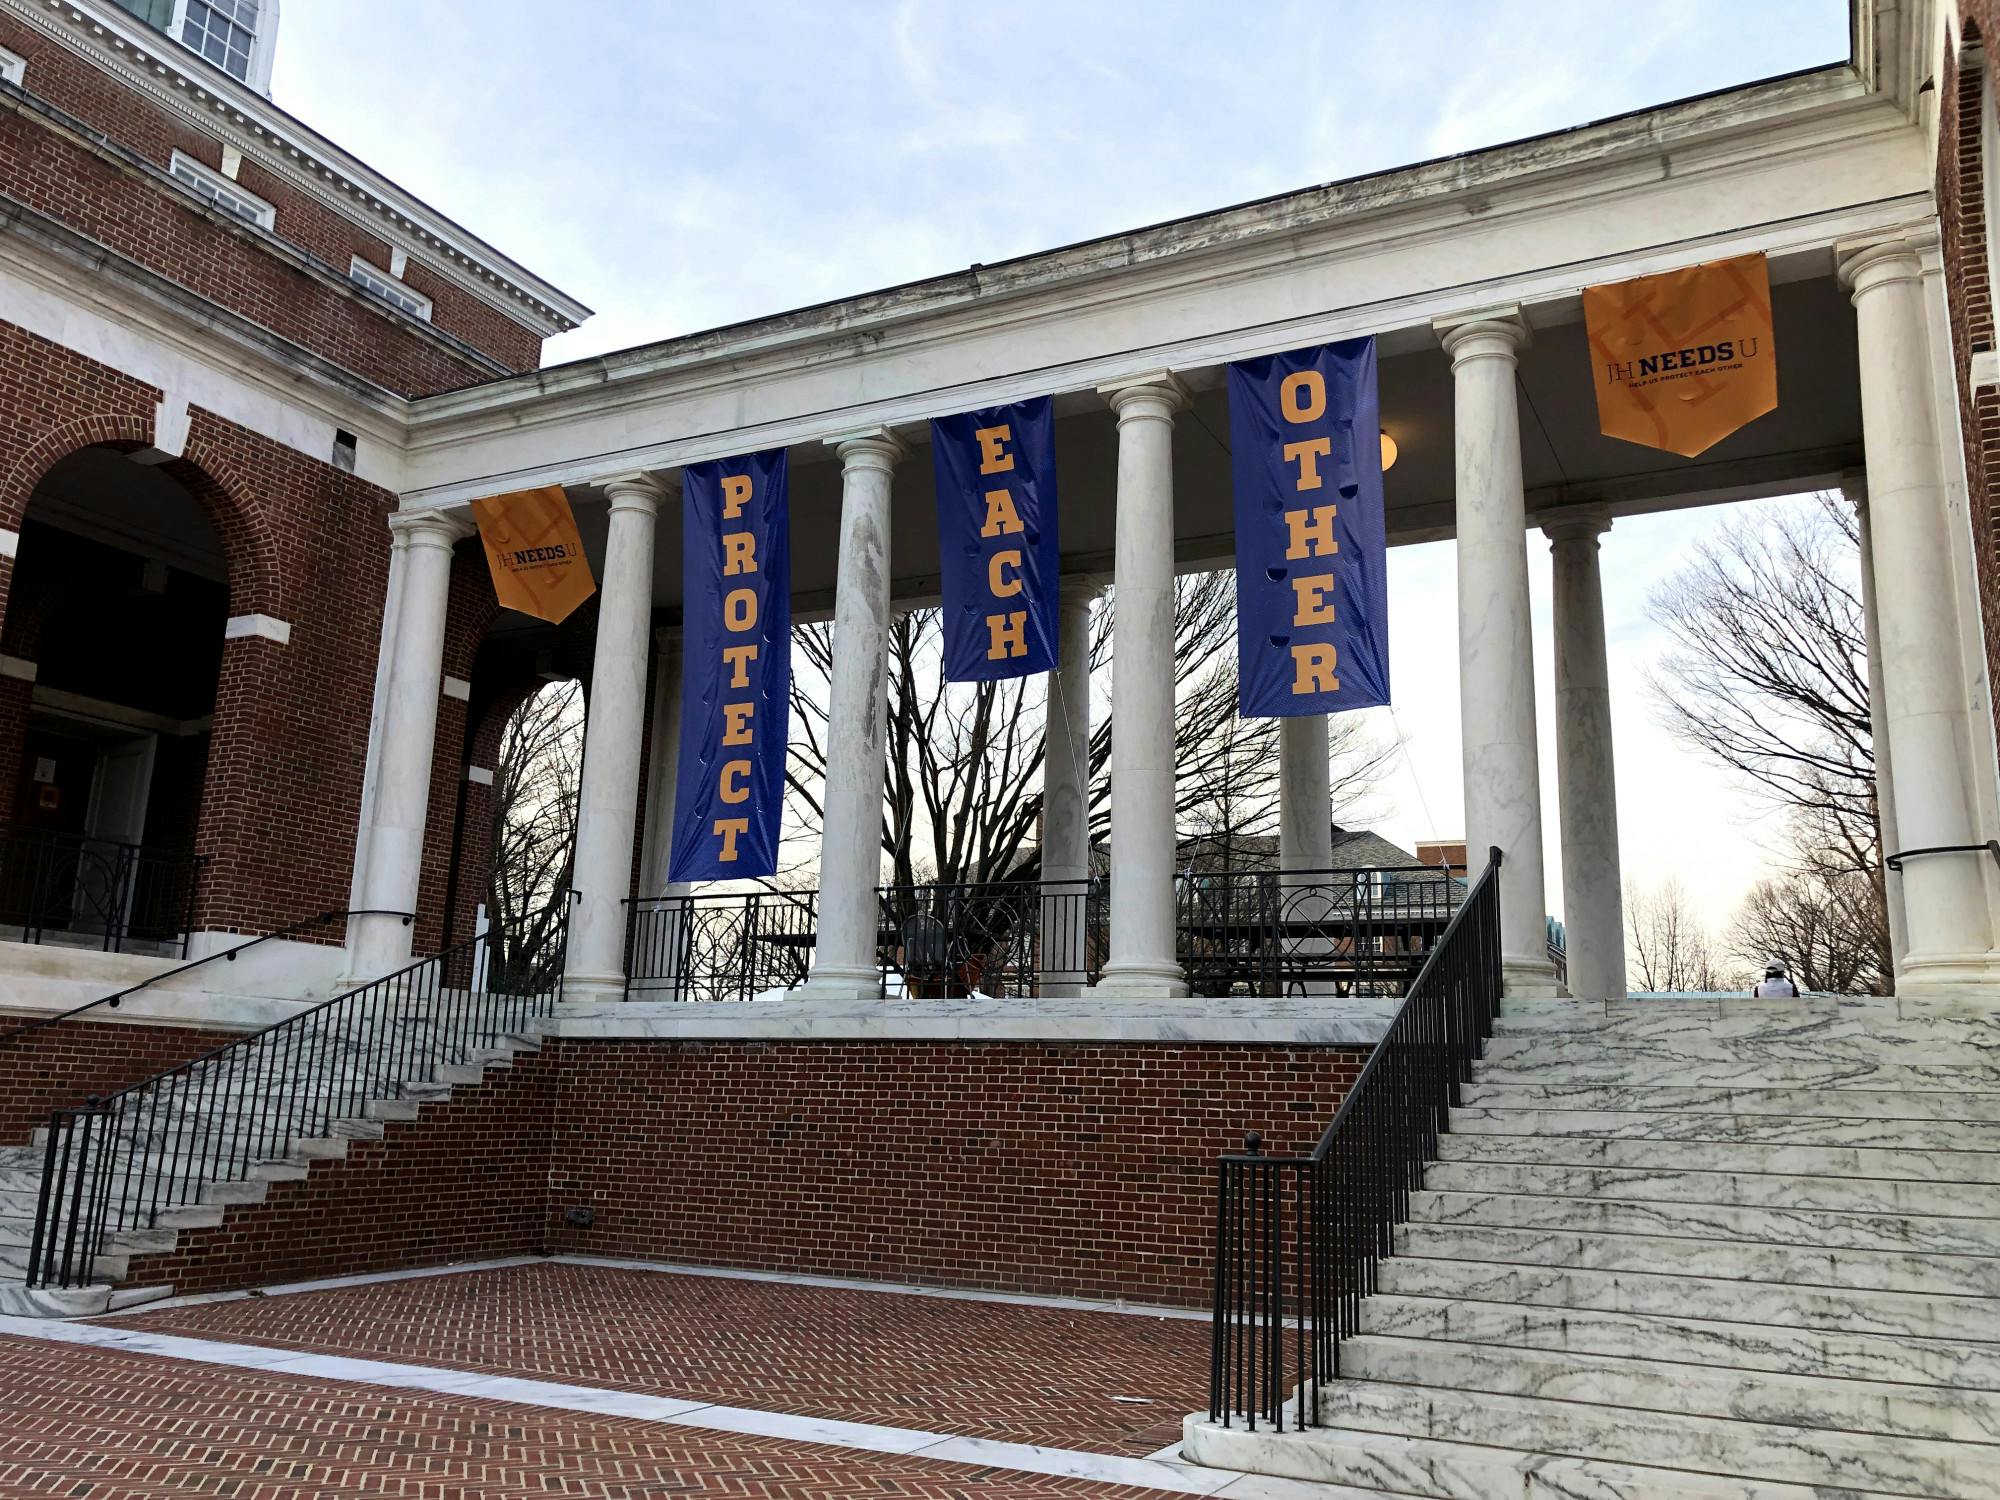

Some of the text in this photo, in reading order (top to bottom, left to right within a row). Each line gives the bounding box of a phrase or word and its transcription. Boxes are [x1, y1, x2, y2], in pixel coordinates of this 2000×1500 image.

[1607, 338, 1758, 384] JH NEEDS U
[1660, 372, 1692, 382] PROTECT
[1695, 367, 1716, 376] EACH
[1718, 363, 1743, 372] OTHER
[514, 544, 566, 564] NEEDS
[975, 424, 1028, 660] EACH
[1280, 370, 1340, 695] OTHER
[713, 474, 758, 862] PROTECT
